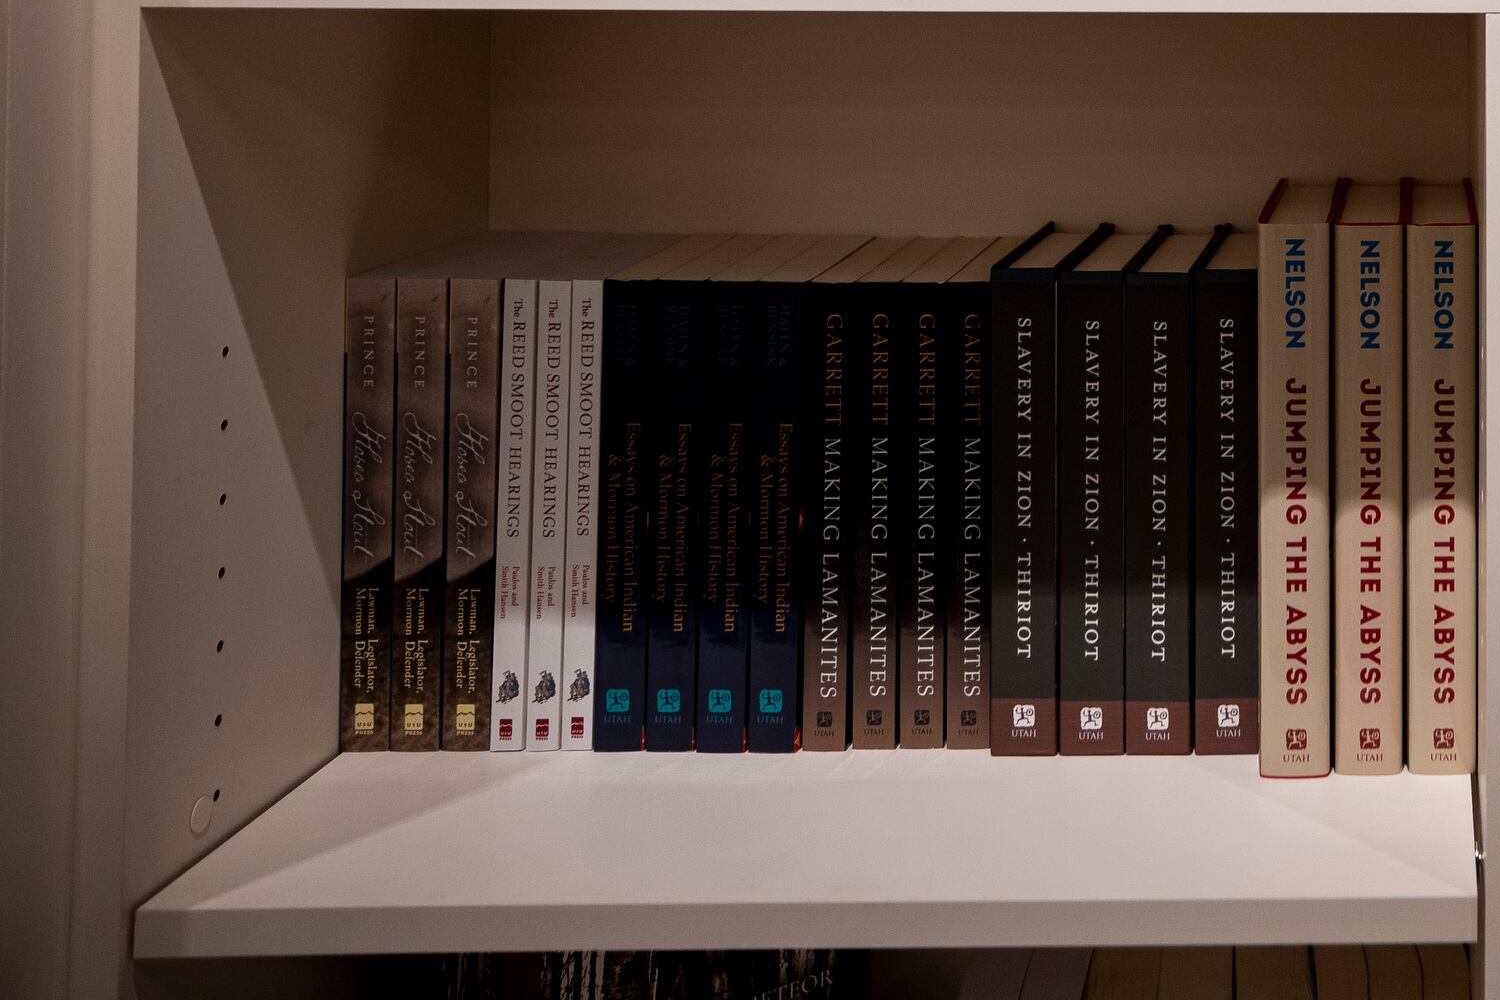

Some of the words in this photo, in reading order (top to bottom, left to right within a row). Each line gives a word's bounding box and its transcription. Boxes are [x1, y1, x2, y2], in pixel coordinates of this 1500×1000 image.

[582, 298, 592, 317] The
[1285, 239, 1306, 348] NELSON
[466, 317, 478, 388] PRINCE
[581, 320, 595, 367] REED
[872, 313, 889, 425] GARRETT
[1017, 318, 1032, 421] SLAVERY
[579, 372, 594, 439] SMOOT
[456, 413, 489, 486] Hosea
[760, 454, 774, 467] &
[778, 423, 793, 474] Essays
[1017, 433, 1031, 458] IN
[1282, 377, 1310, 525] JUMPING
[577, 446, 591, 536] HEARINGS
[759, 474, 774, 540] Mormon
[778, 477, 788, 497] on
[871, 437, 888, 539] MAKING
[1017, 471, 1032, 528] ZION
[454, 491, 486, 559] Stout
[776, 502, 791, 577] American
[571, 564, 580, 587] Smith
[582, 565, 590, 589] Paulos
[753, 546, 772, 604] History
[1286, 536, 1307, 593] THE
[457, 589, 469, 636] Mormon
[469, 589, 481, 634] Lawman,
[568, 589, 580, 620] Hansen
[582, 590, 590, 605] and
[775, 583, 790, 632] Indian
[869, 552, 888, 697] LAMANITES
[1017, 552, 1031, 658] THIRIOT
[456, 641, 469, 689] Defender
[467, 640, 480, 694] Legislator,
[1286, 604, 1308, 704] ABYSS
[757, 713, 784, 724] UTAH
[1011, 729, 1036, 738] UTAH
[1283, 754, 1310, 762] UTAH
